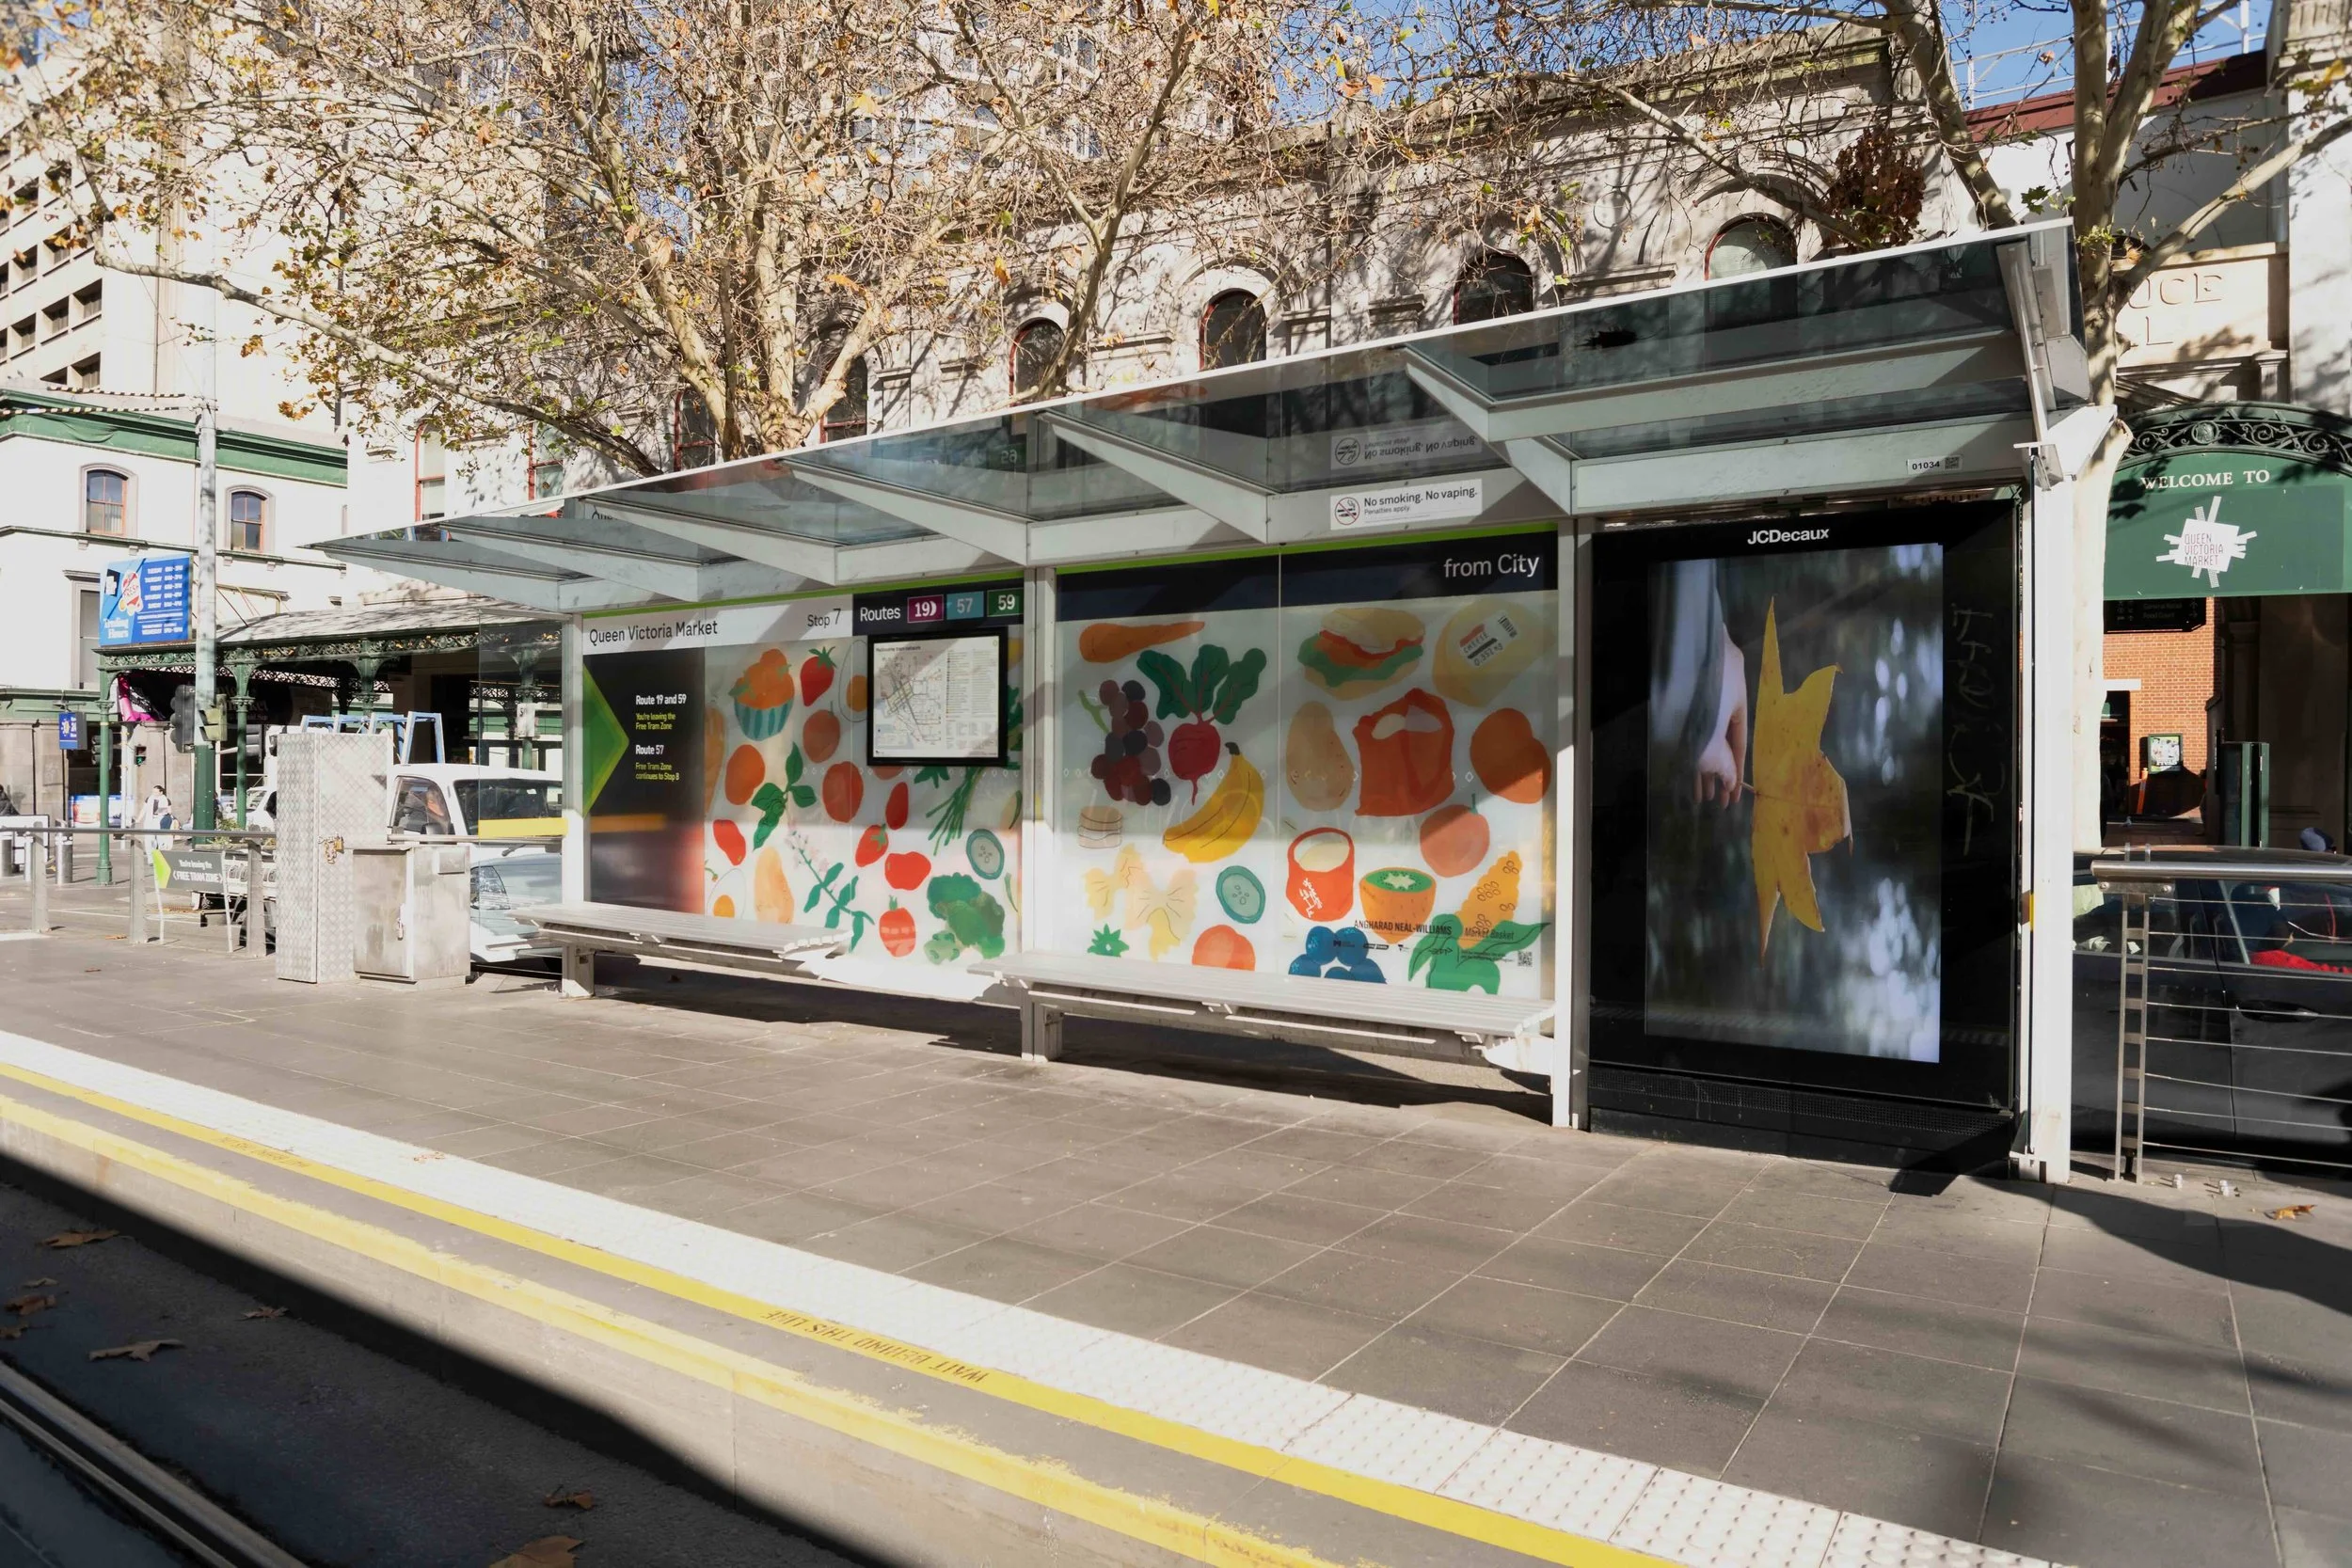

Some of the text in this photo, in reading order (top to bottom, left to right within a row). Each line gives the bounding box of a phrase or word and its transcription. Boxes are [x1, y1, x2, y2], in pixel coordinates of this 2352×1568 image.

[1912, 460, 1940, 470] 01034
[2140, 469, 2270, 489] WELCOME TO
[1365, 486, 1477, 507] No smoking. No vaping.
[1747, 528, 1829, 545] JCDecaux
[2185, 533, 2212, 545] QUEEN
[2185, 544, 2224, 555] VICTORIA
[1443, 554, 1539, 578] from City
[2185, 555, 2219, 566] MARKET
[957, 598, 973, 613] 57
[998, 594, 1016, 610] 59
[807, 608, 842, 628] Stop 7
[860, 607, 901, 622] Routes
[590, 620, 718, 647] Queen Victoria Market
[635, 693, 687, 705] Route 19 and 59
[650, 713, 667, 721] leaving
[636, 721, 673, 730] Free Tram Zone
[635, 744, 664, 755] Route 57
[635, 762, 673, 770] Free Tram Zone
[664, 772, 675, 782] Stop
[190, 871, 205, 881] TRAM
[1354, 919, 1453, 936] ANGHARAD NEAL-WILLIAMS
[1464, 927, 1515, 941] Market Basket
[765, 1309, 990, 1384] WAIT BEHIND THIS LINE
